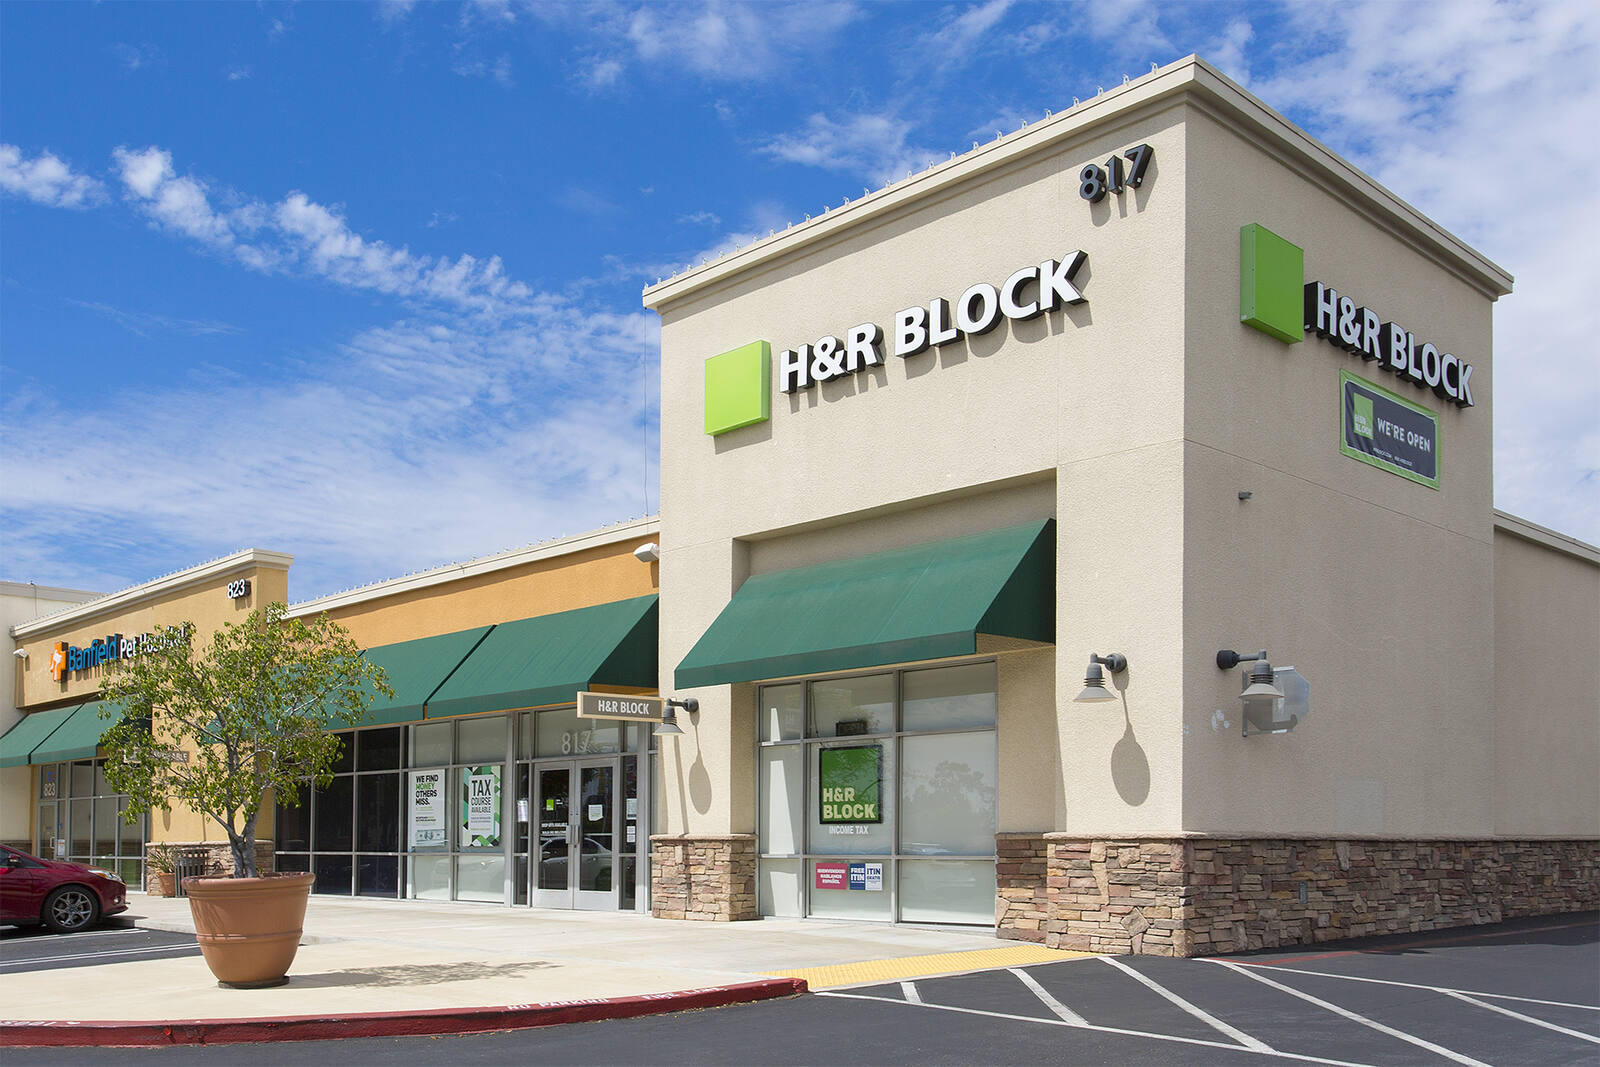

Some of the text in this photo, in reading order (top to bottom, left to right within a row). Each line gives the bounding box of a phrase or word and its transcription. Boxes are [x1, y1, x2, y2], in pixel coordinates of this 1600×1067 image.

[1079, 143, 1154, 203] 817
[780, 249, 1088, 394] H&R BLOCK
[1304, 280, 1475, 408] H&R BLOCK
[1377, 417, 1431, 453] WE'RE OPEN
[227, 578, 251, 599] 823
[68, 633, 122, 672] Banfield
[120, 635, 139, 659] Pet
[598, 699, 650, 715] H&R BLOCK
[561, 728, 593, 755] 817
[415, 774, 439, 783] WE FIND
[415, 782, 435, 790] MONEY
[43, 782, 56, 797] 823
[415, 790, 438, 798] OTHERS
[471, 779, 492, 796] TAX
[823, 787, 855, 802] H&R
[415, 797, 431, 806] MISS.
[471, 796, 492, 806] COURSE
[823, 803, 876, 819] BLOCK
[829, 825, 869, 834] INCOME TAX
[866, 867, 881, 875] ITIN
